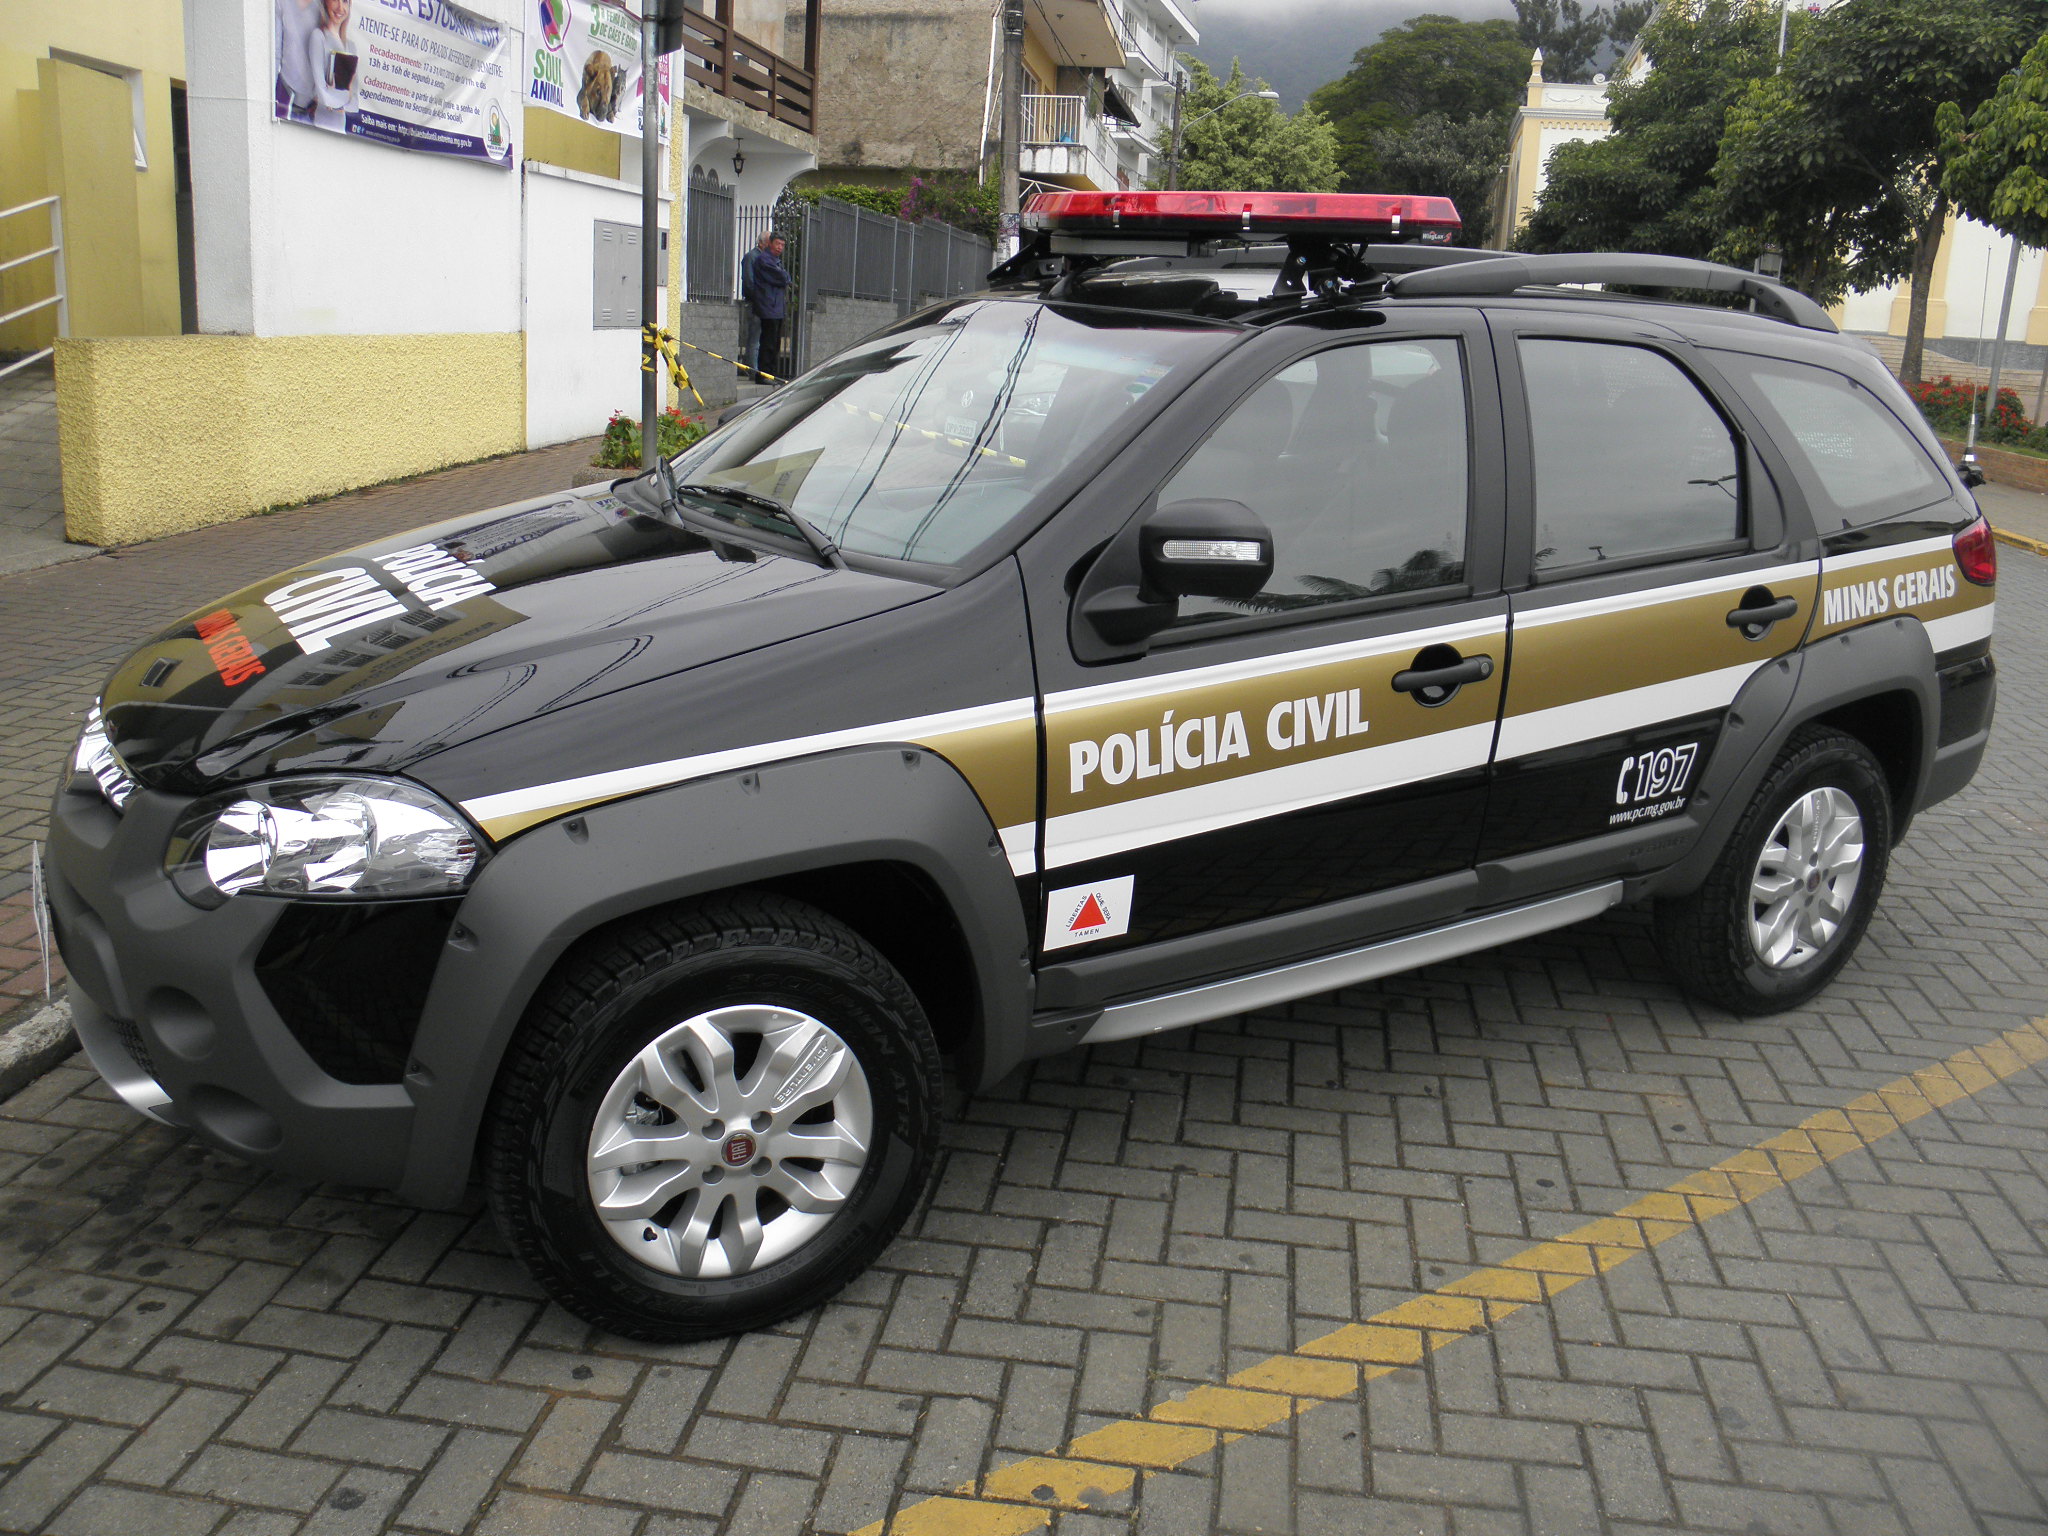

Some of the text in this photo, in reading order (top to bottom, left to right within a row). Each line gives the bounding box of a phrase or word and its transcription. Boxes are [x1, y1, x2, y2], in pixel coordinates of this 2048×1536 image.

[359, 16, 401, 42] ATENTE-SE
[401, 30, 419, 49] PARA
[420, 38, 429, 52] OS
[430, 41, 449, 60] PRAZOS
[369, 44, 422, 68] Recadastramento:
[369, 57, 381, 69] 13h
[382, 61, 390, 71] às
[391, 65, 403, 76] 16h
[403, 68, 411, 78] de
[411, 73, 431, 85] segunda
[533, 48, 564, 88] SOUL
[359, 88, 405, 109] agendamento
[404, 101, 412, 110] na
[363, 75, 411, 97] Cadastramento:
[415, 91, 429, 102] partir
[460, 105, 473, 114] senha
[474, 106, 480, 116] de
[530, 78, 564, 108] ANIMAL
[361, 114, 375, 126] Saiba
[375, 119, 388, 130] mais
[372, 543, 497, 611] POLÍCIA
[1823, 563, 1956, 625] MINAS GERAIS
[264, 567, 409, 656] CIVIL
[208, 635, 267, 687] GERAIS
[1068, 687, 1369, 794] POLÍCIA CIVIL
[1633, 742, 1698, 801] 197
[1609, 795, 1687, 825] www.pc.mg.gov.br
[1065, 892, 1112, 928] LIBERTAS QUE SERA
[1074, 928, 1100, 938] TAMEN
[731, 1139, 748, 1161] FIAT
